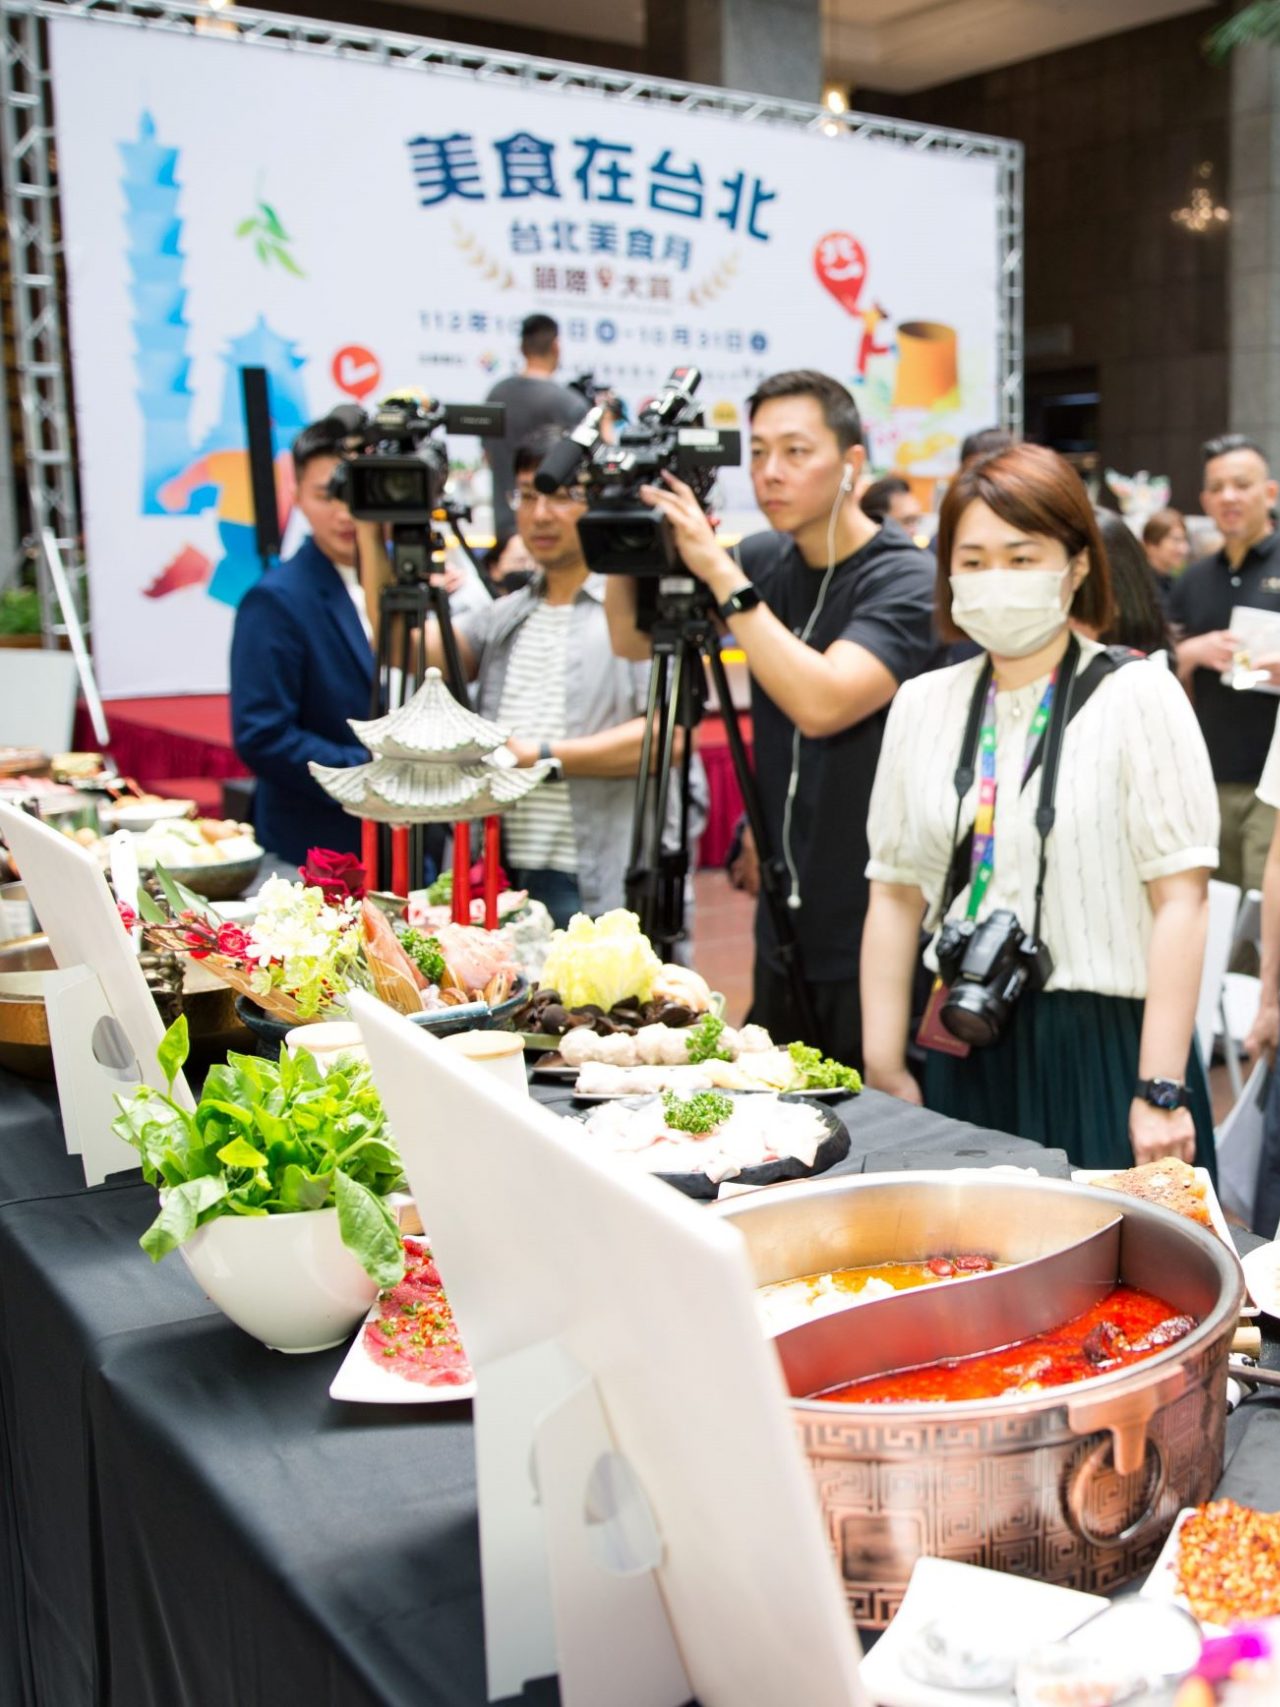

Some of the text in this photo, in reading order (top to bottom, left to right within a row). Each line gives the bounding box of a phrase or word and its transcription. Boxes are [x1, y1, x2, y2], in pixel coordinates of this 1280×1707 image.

[407, 131, 777, 242] 美食在台北
[510, 218, 694, 271] 台北美食月
